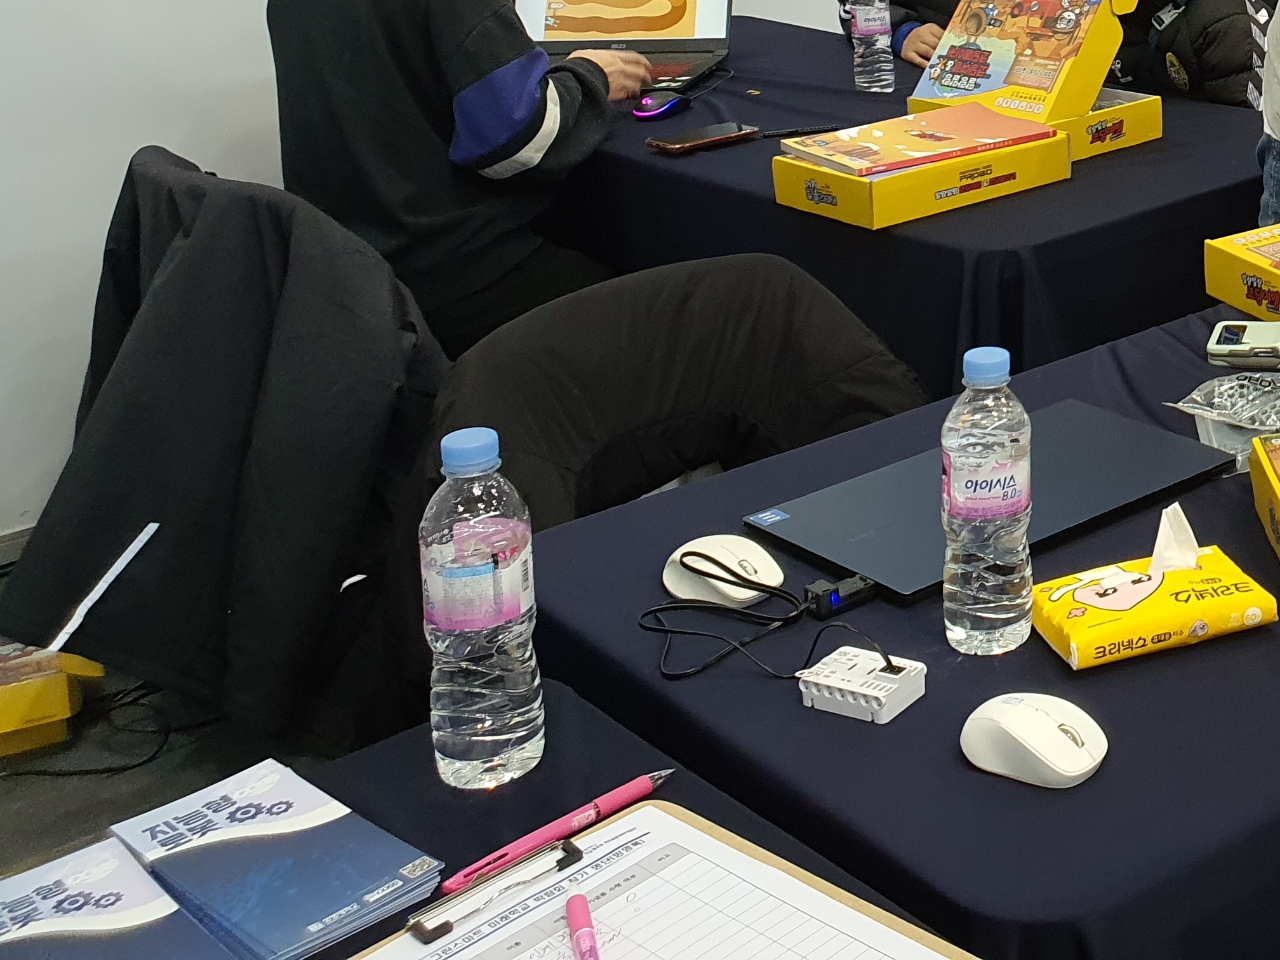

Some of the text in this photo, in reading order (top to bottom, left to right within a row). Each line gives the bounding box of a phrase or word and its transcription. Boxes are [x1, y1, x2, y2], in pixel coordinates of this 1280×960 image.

[959, 169, 993, 183] PROBO
[964, 474, 1018, 494] 아이시스
[1001, 488, 1017, 502] 8.0
[1093, 637, 1149, 660] 크리넥스
[141, 793, 239, 844] 지능형
[162, 820, 223, 853] 로봇
[488, 903, 531, 929] 미래학교
[533, 885, 566, 904] 박람회
